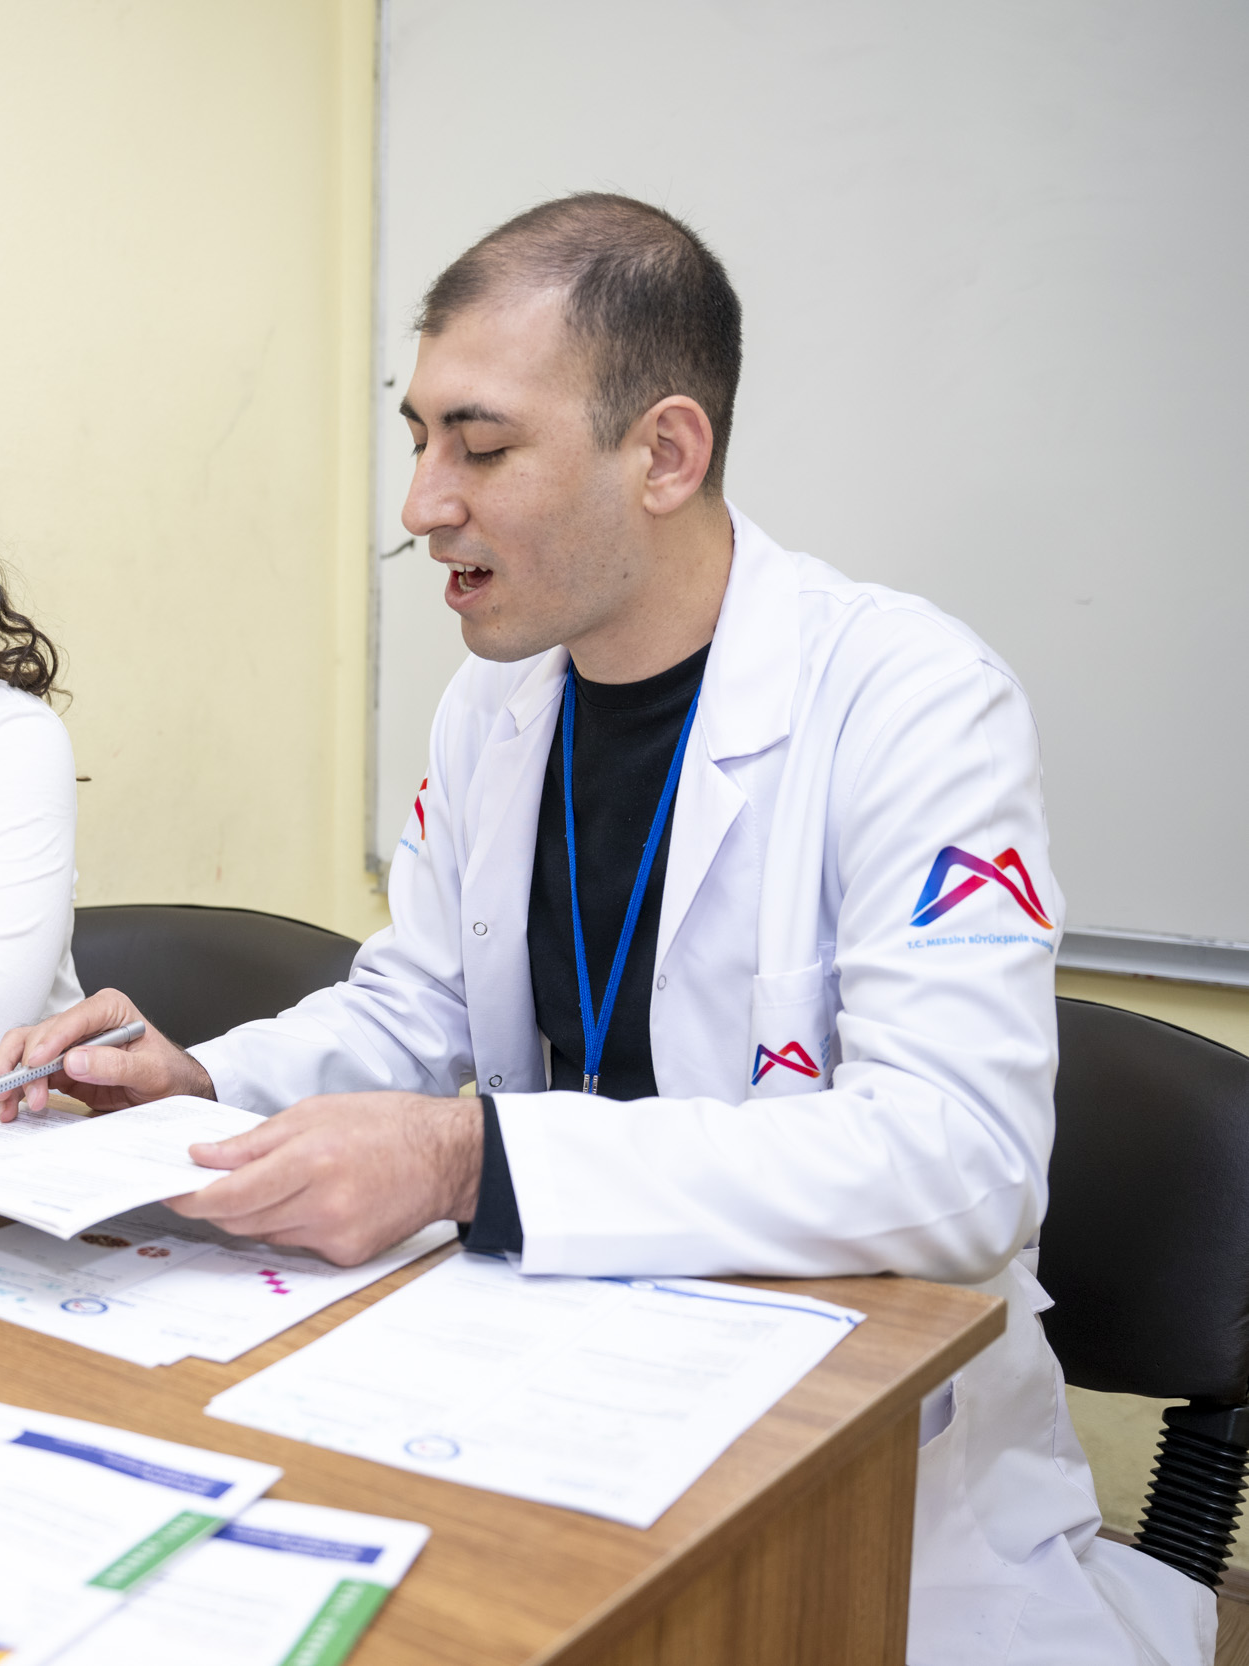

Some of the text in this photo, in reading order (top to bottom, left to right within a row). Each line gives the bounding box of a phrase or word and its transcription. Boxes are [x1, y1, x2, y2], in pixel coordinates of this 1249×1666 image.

[907, 941, 925, 950] T.C.
[926, 935, 966, 947] MERSİN
[968, 933, 1030, 946] BÜYÜKŞEHİR
